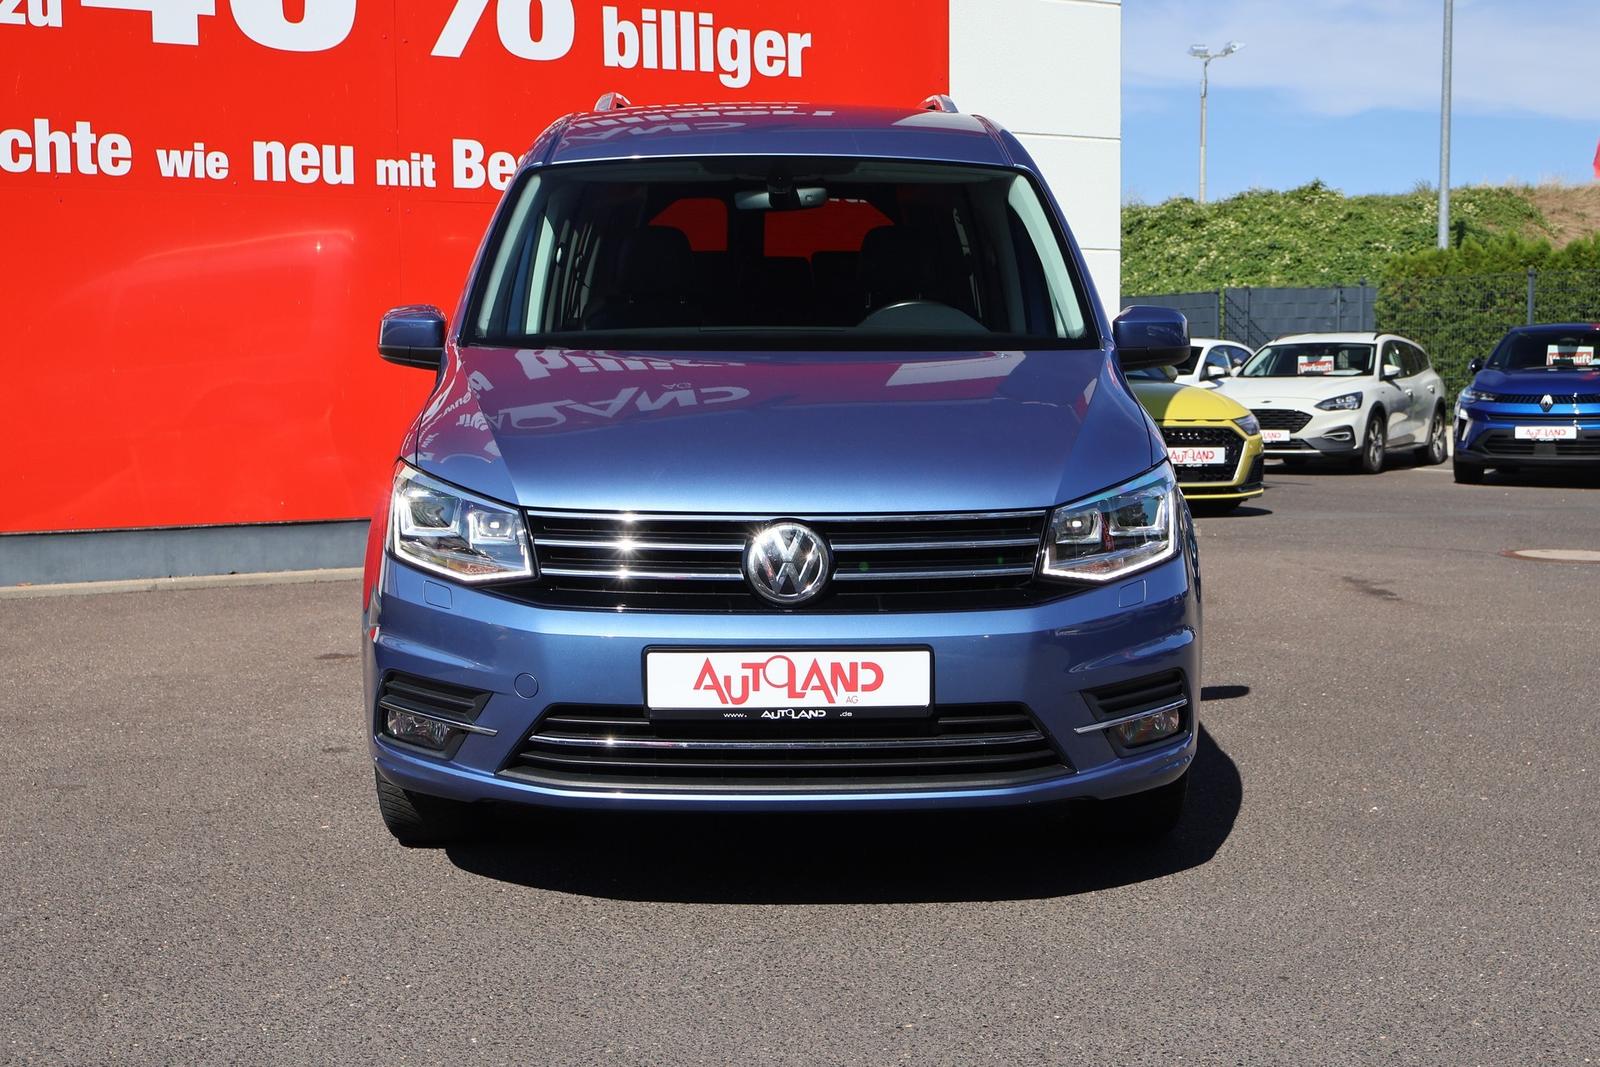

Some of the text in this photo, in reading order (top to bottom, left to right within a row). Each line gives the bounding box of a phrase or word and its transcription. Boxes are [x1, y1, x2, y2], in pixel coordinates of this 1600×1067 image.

[602, 5, 812, 89] billiger
[0, 118, 521, 192] chte wie neu mit Be
[692, 654, 884, 706] AUTOLAND
[845, 695, 859, 704] AG
